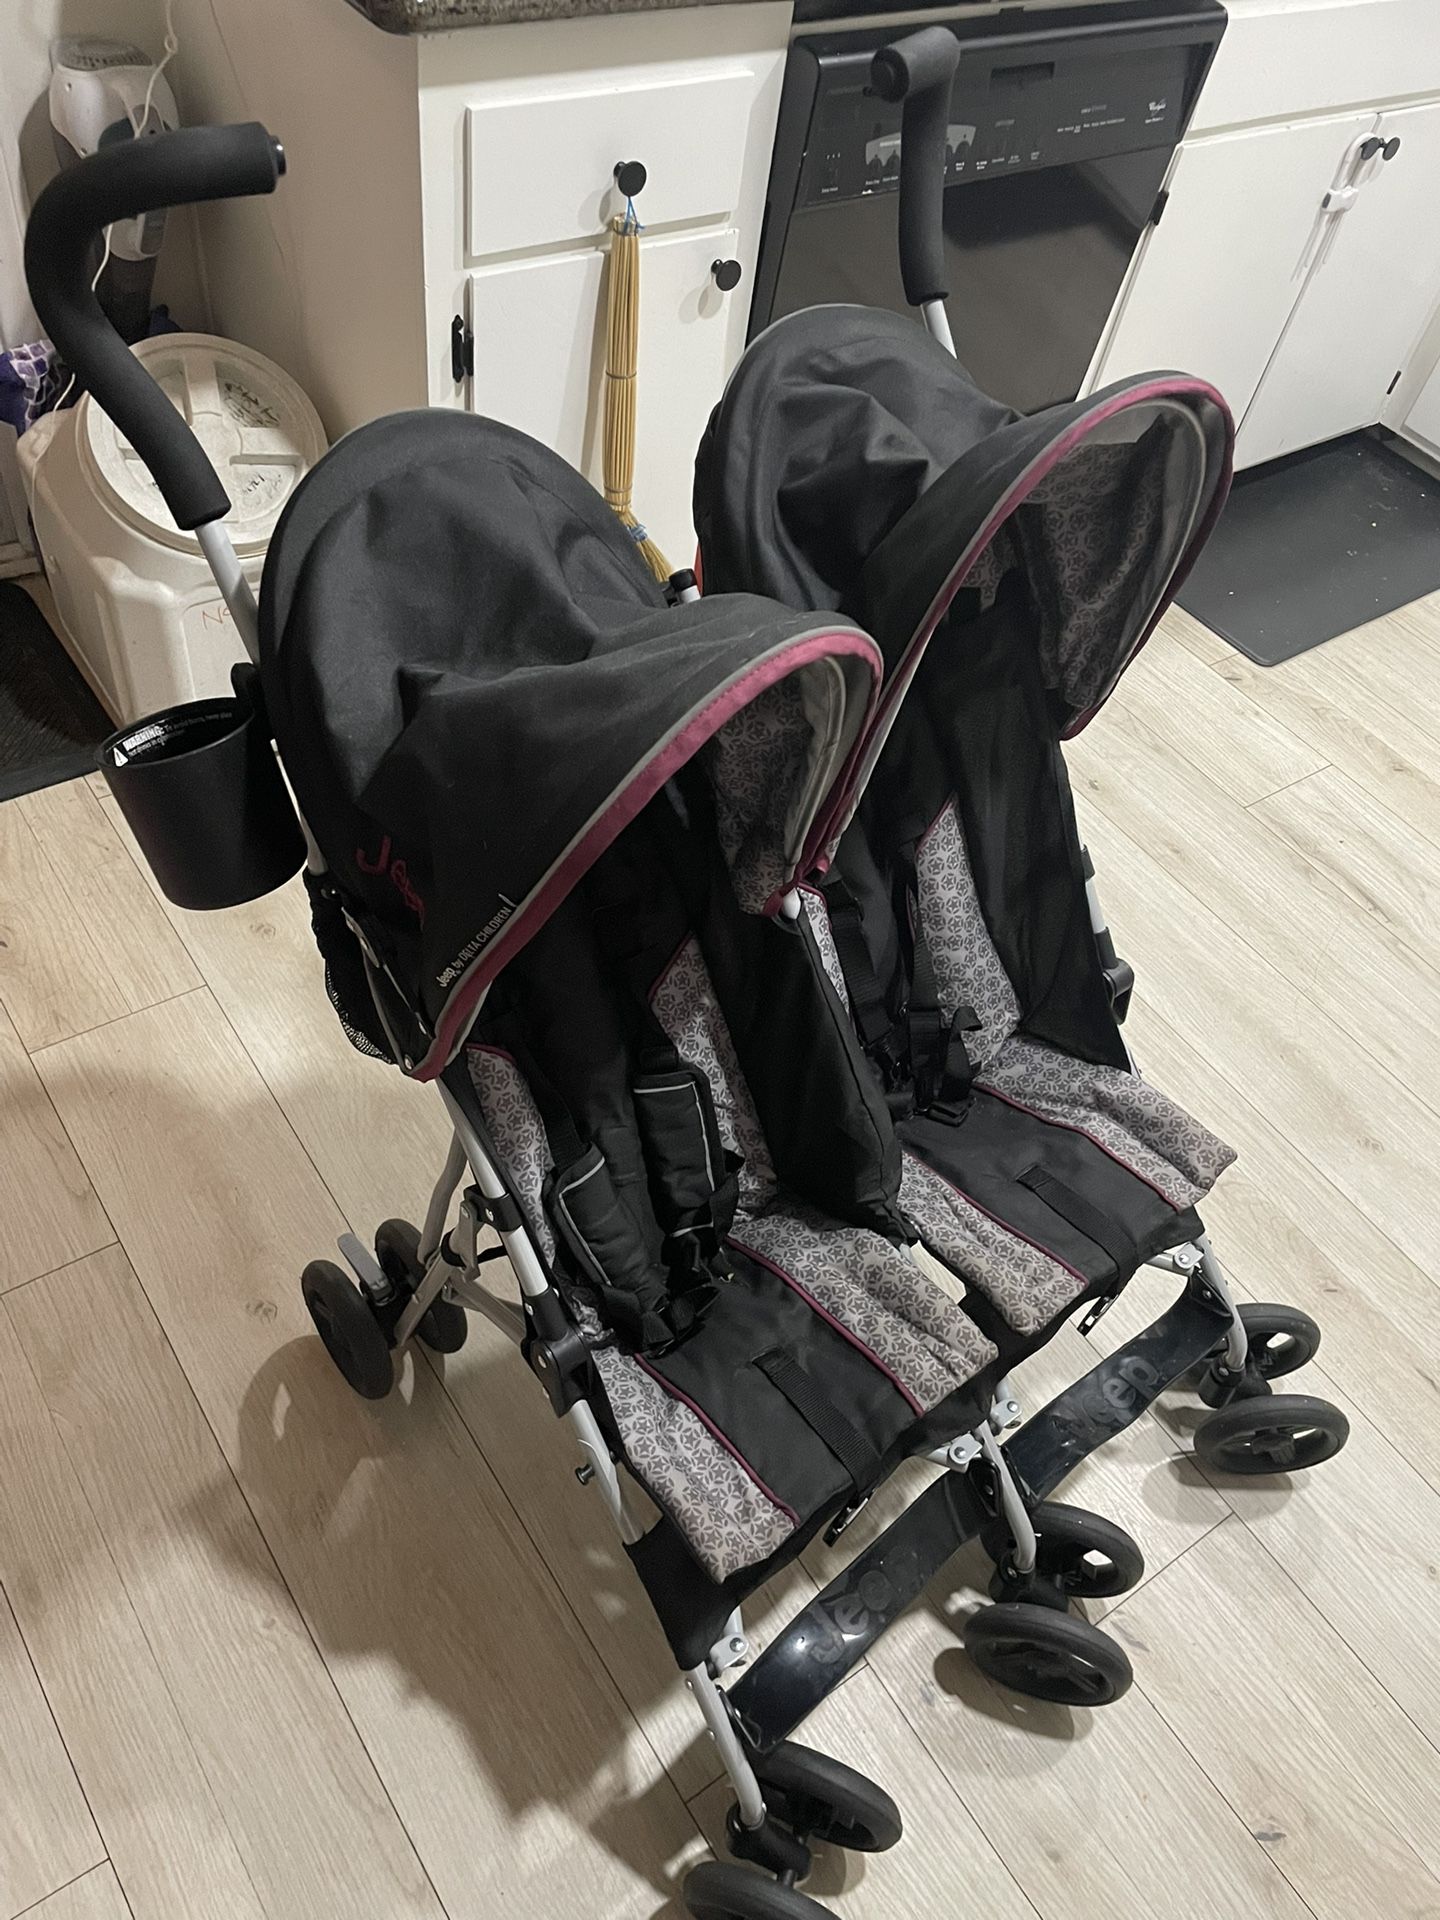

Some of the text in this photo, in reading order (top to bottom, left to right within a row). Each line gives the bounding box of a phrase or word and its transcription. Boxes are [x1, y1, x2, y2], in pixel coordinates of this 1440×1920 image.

[436, 906, 512, 988] Jeep by DELTA CHILDREN
